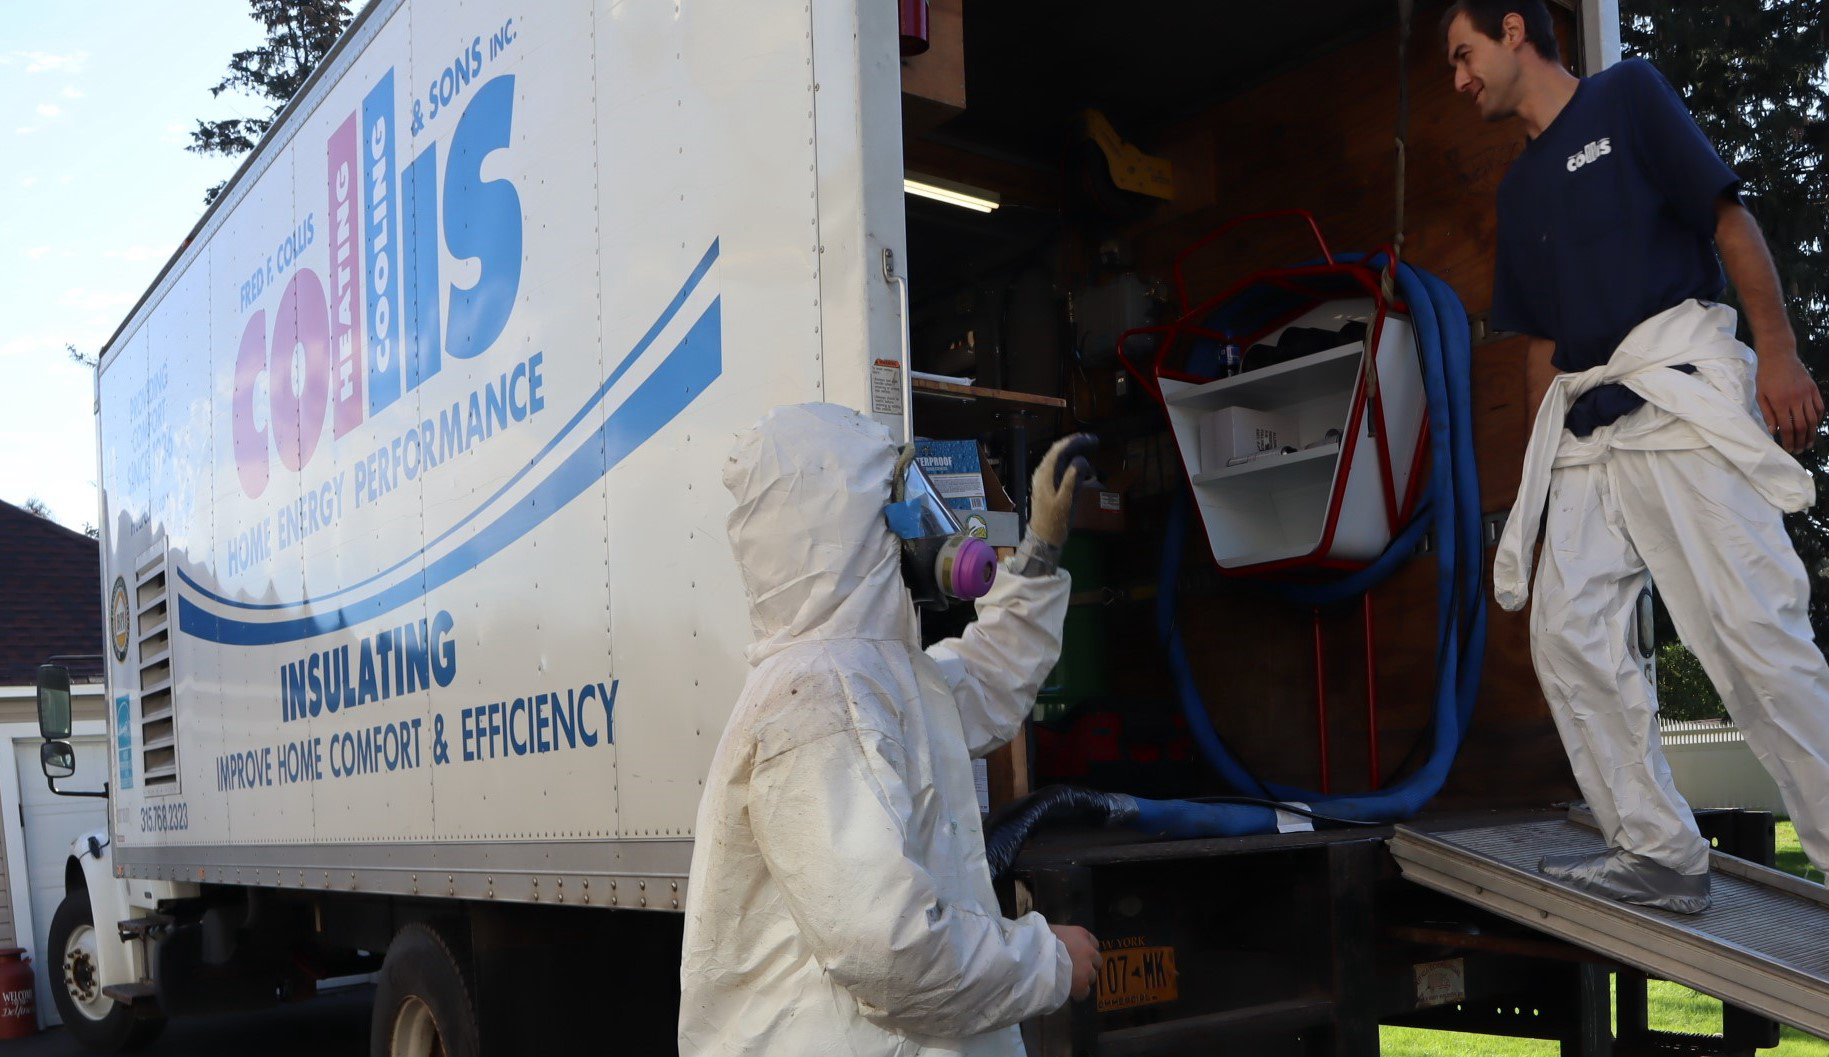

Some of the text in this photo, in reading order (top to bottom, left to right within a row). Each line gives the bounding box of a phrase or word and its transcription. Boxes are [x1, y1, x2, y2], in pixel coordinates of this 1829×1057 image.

[411, 18, 517, 137] & SONS INC.
[240, 212, 315, 313] FRED F. COLLIS
[336, 160, 354, 402] HEATING
[371, 115, 390, 373] COOLING
[130, 363, 168, 420] PROVIDING
[227, 517, 271, 578] HOME
[278, 471, 346, 552] ENERGY
[354, 351, 545, 509] PERFORMANCE
[915, 456, 952, 467] TERPROOF
[280, 609, 457, 723] INSULATING
[216, 680, 620, 792] IMPROVE HOME COMFORT & EFFICIENCY
[140, 802, 189, 833] 315.768.2323
[1116, 936, 1146, 948] YORK
